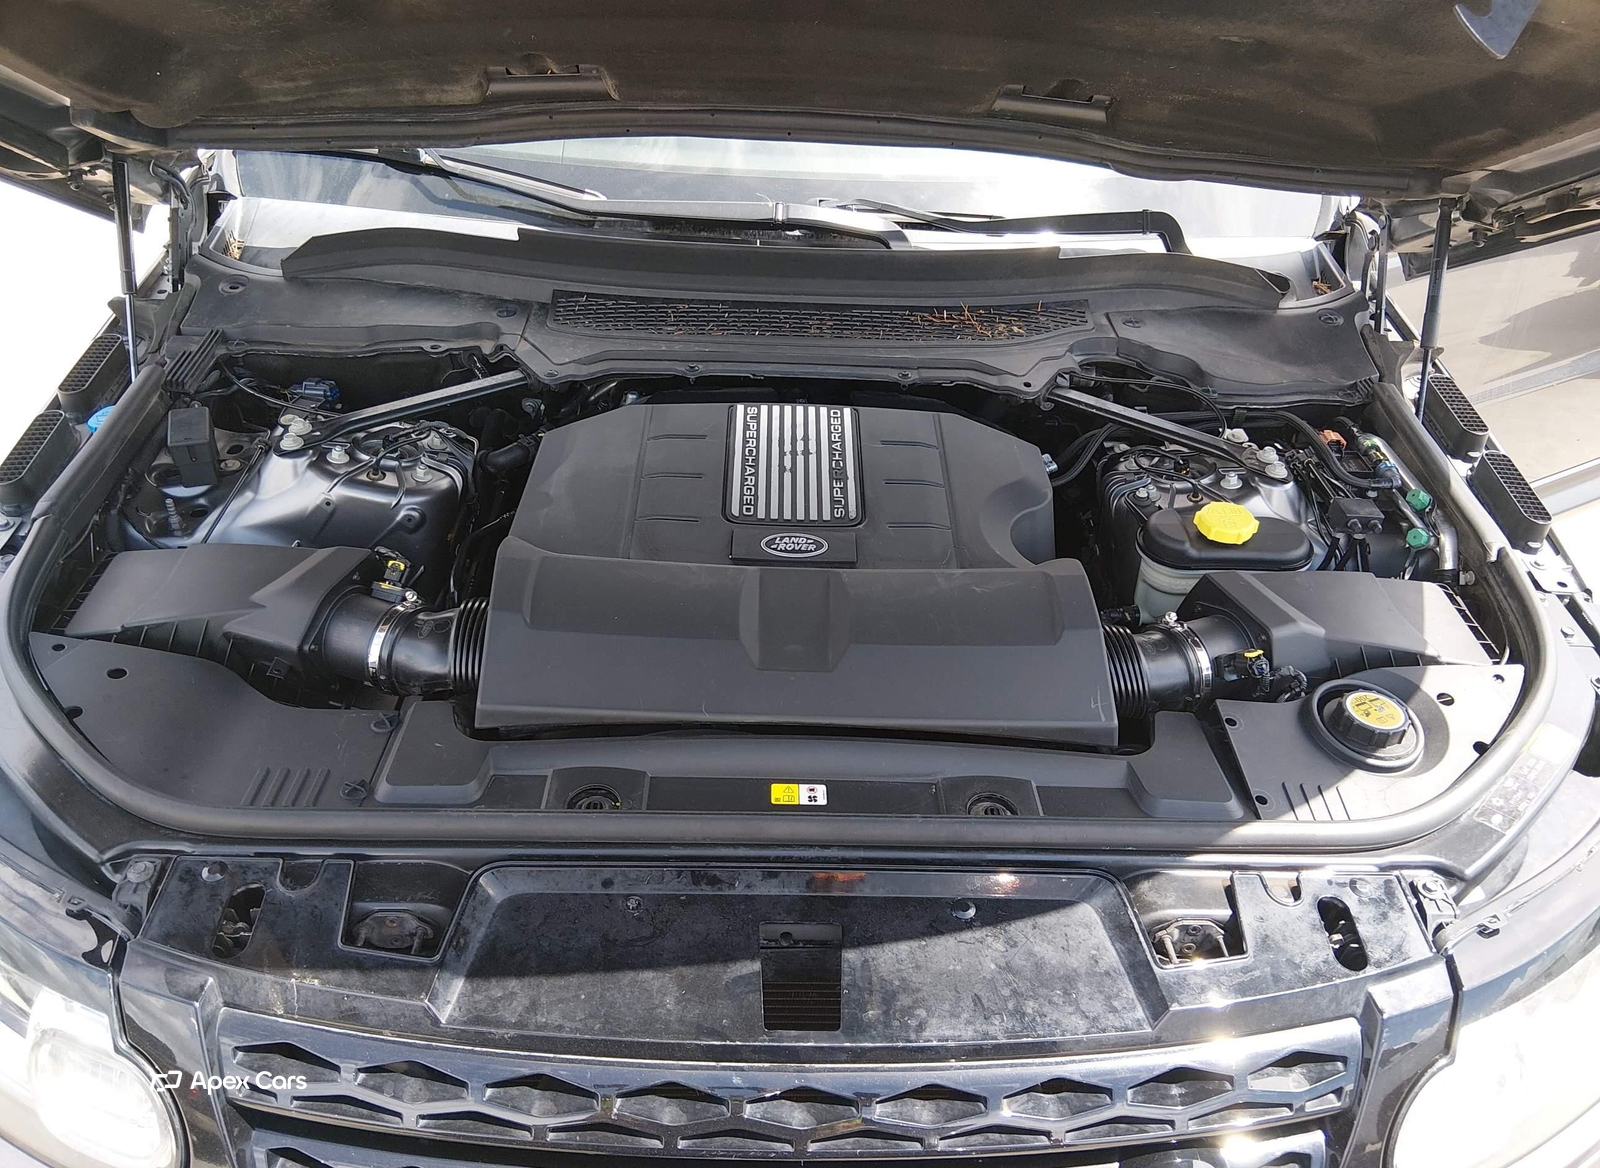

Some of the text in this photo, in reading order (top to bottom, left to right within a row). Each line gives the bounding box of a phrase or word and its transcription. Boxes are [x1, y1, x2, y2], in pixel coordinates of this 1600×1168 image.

[742, 406, 758, 516] SUPERCHARGED
[830, 409, 845, 518] SUPERCHARGED
[774, 536, 807, 544] LAND
